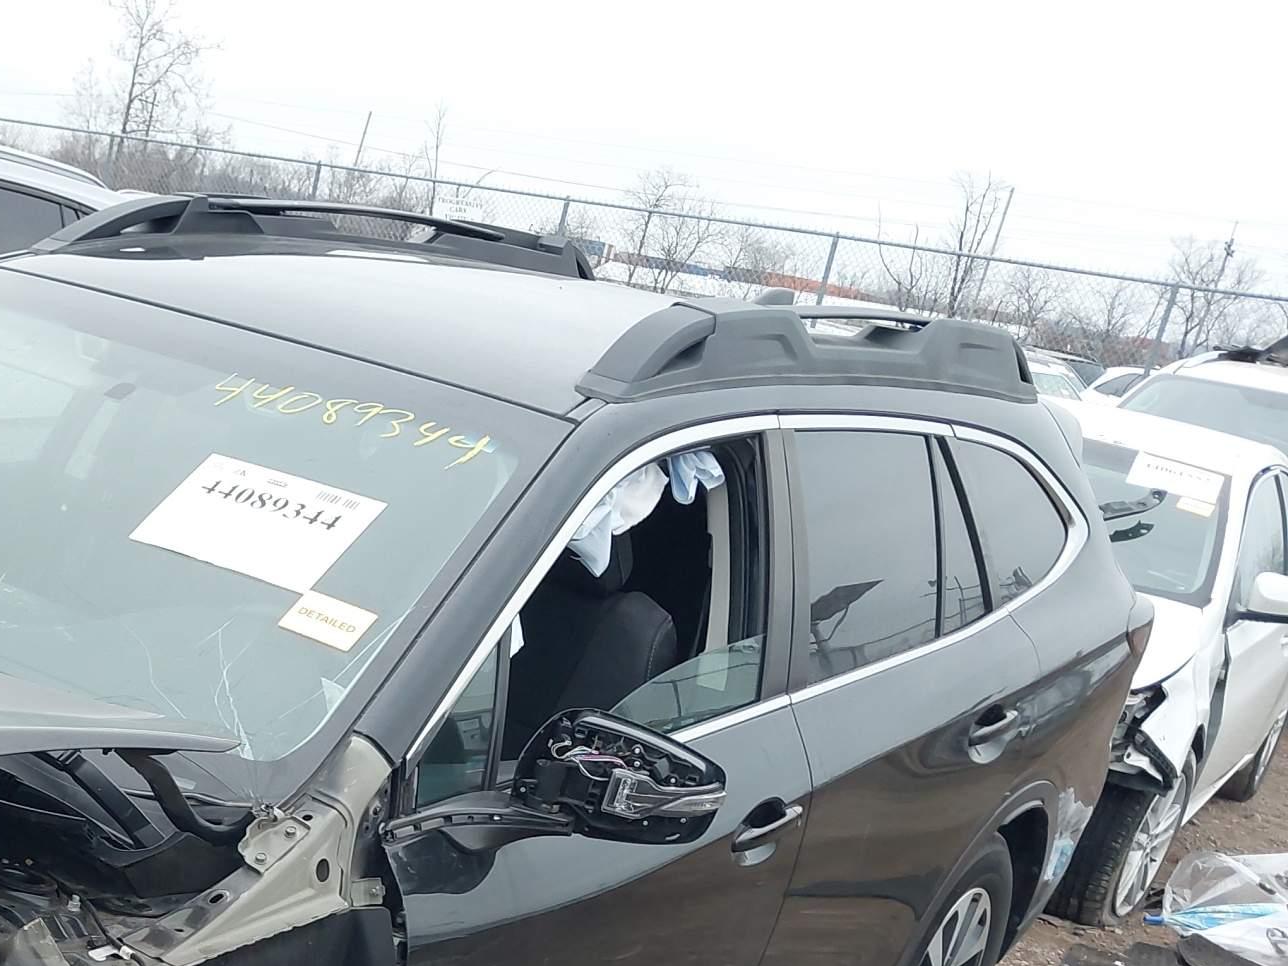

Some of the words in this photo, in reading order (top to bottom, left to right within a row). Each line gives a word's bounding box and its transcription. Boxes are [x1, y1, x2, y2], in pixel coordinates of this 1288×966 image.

[214, 373, 496, 470] 44089344
[201, 480, 342, 531] 44089344
[297, 607, 357, 633] DETAILED
